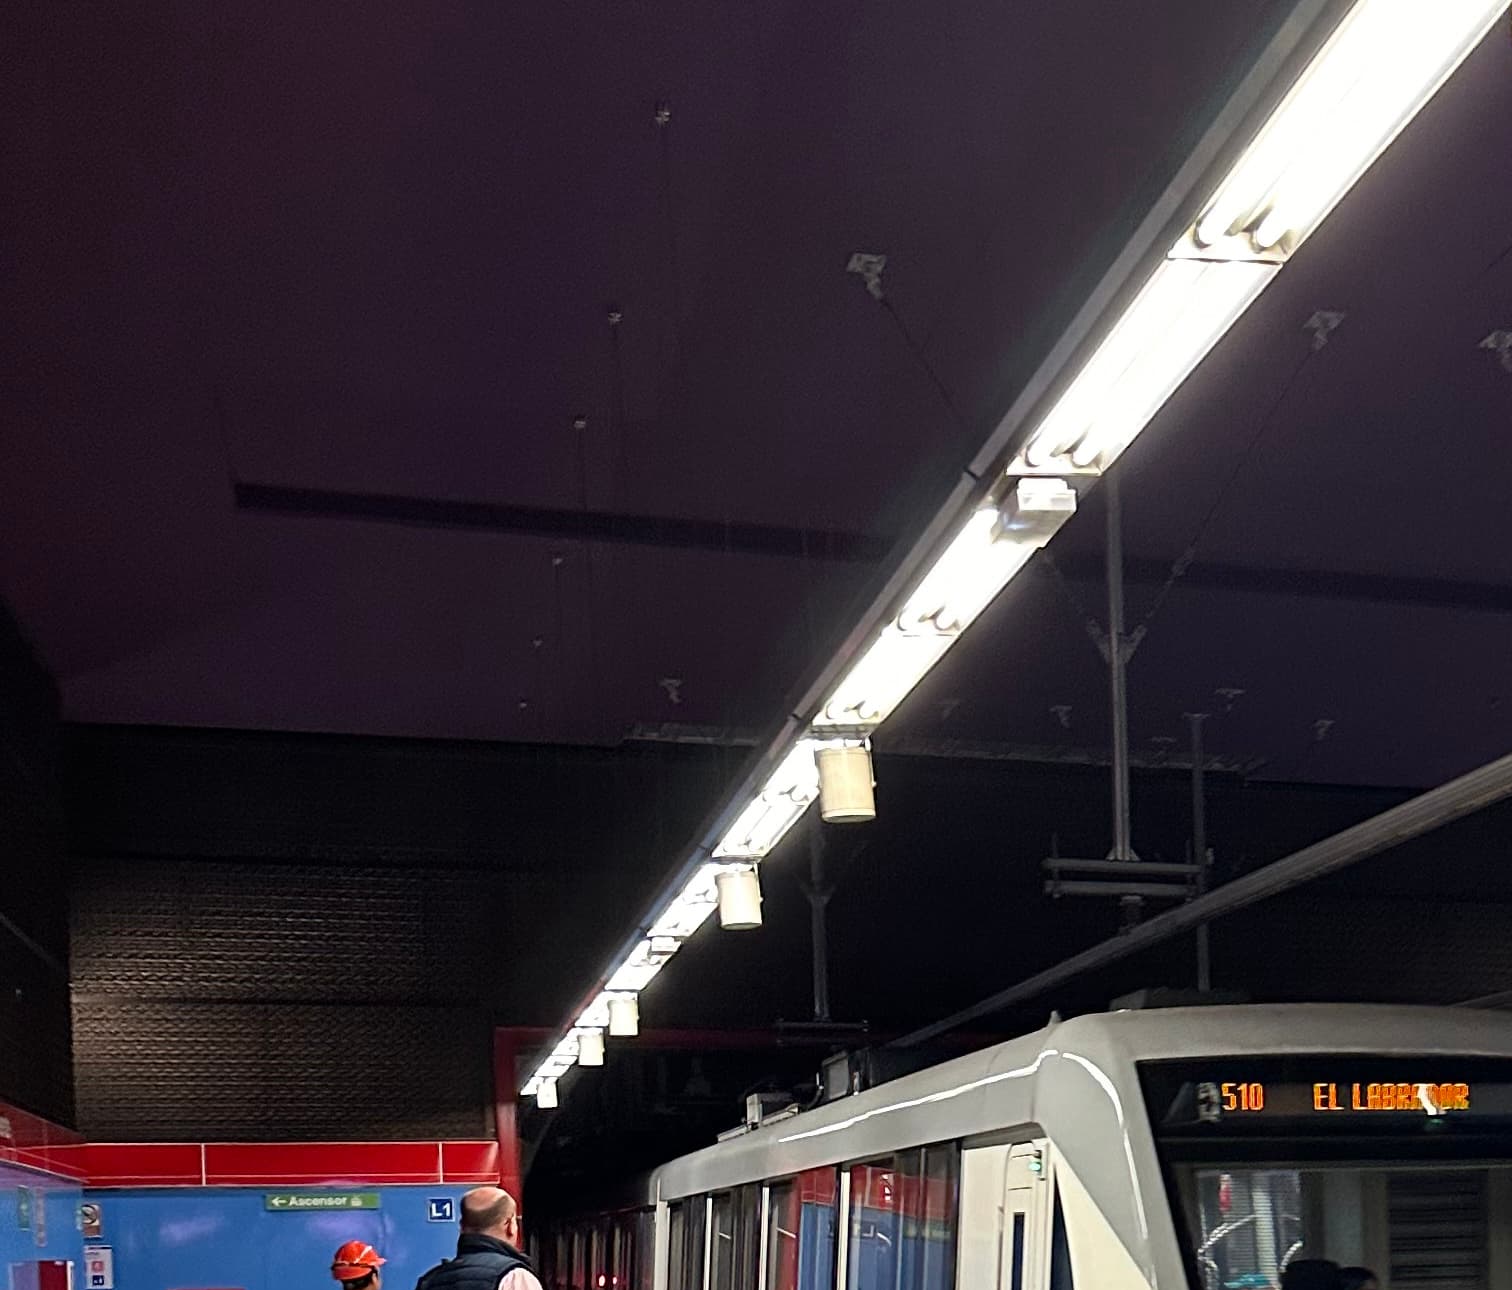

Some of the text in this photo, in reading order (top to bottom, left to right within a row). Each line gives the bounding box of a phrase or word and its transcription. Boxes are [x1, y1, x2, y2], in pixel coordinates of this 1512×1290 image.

[1221, 1083, 1264, 1111] 510
[1313, 1083, 1345, 1111] EL
[288, 1196, 348, 1207] Ascensor
[431, 1203, 451, 1217] L1
